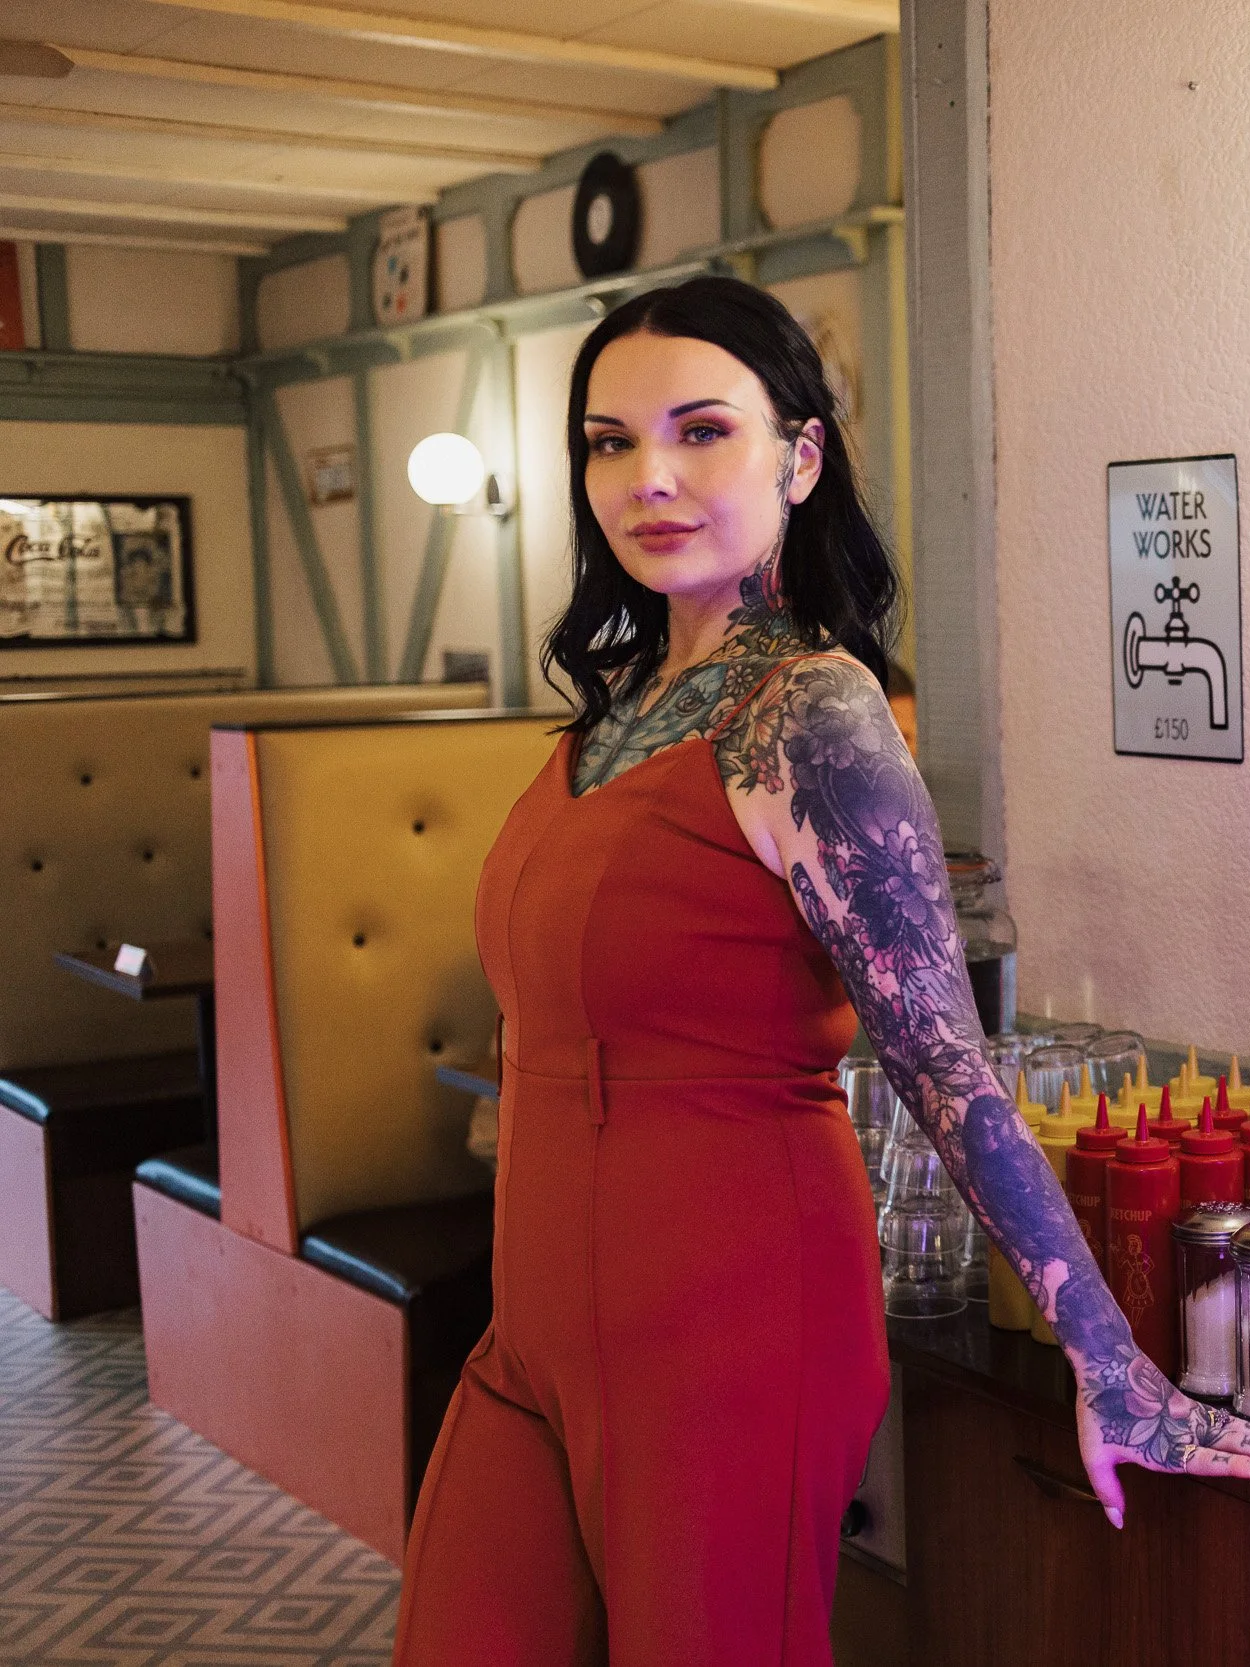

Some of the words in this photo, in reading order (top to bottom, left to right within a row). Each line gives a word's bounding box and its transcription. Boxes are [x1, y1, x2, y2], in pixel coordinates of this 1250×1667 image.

[1135, 490, 1208, 521] WATER
[1133, 528, 1212, 559] WORKS
[1154, 717, 1189, 740] £150
